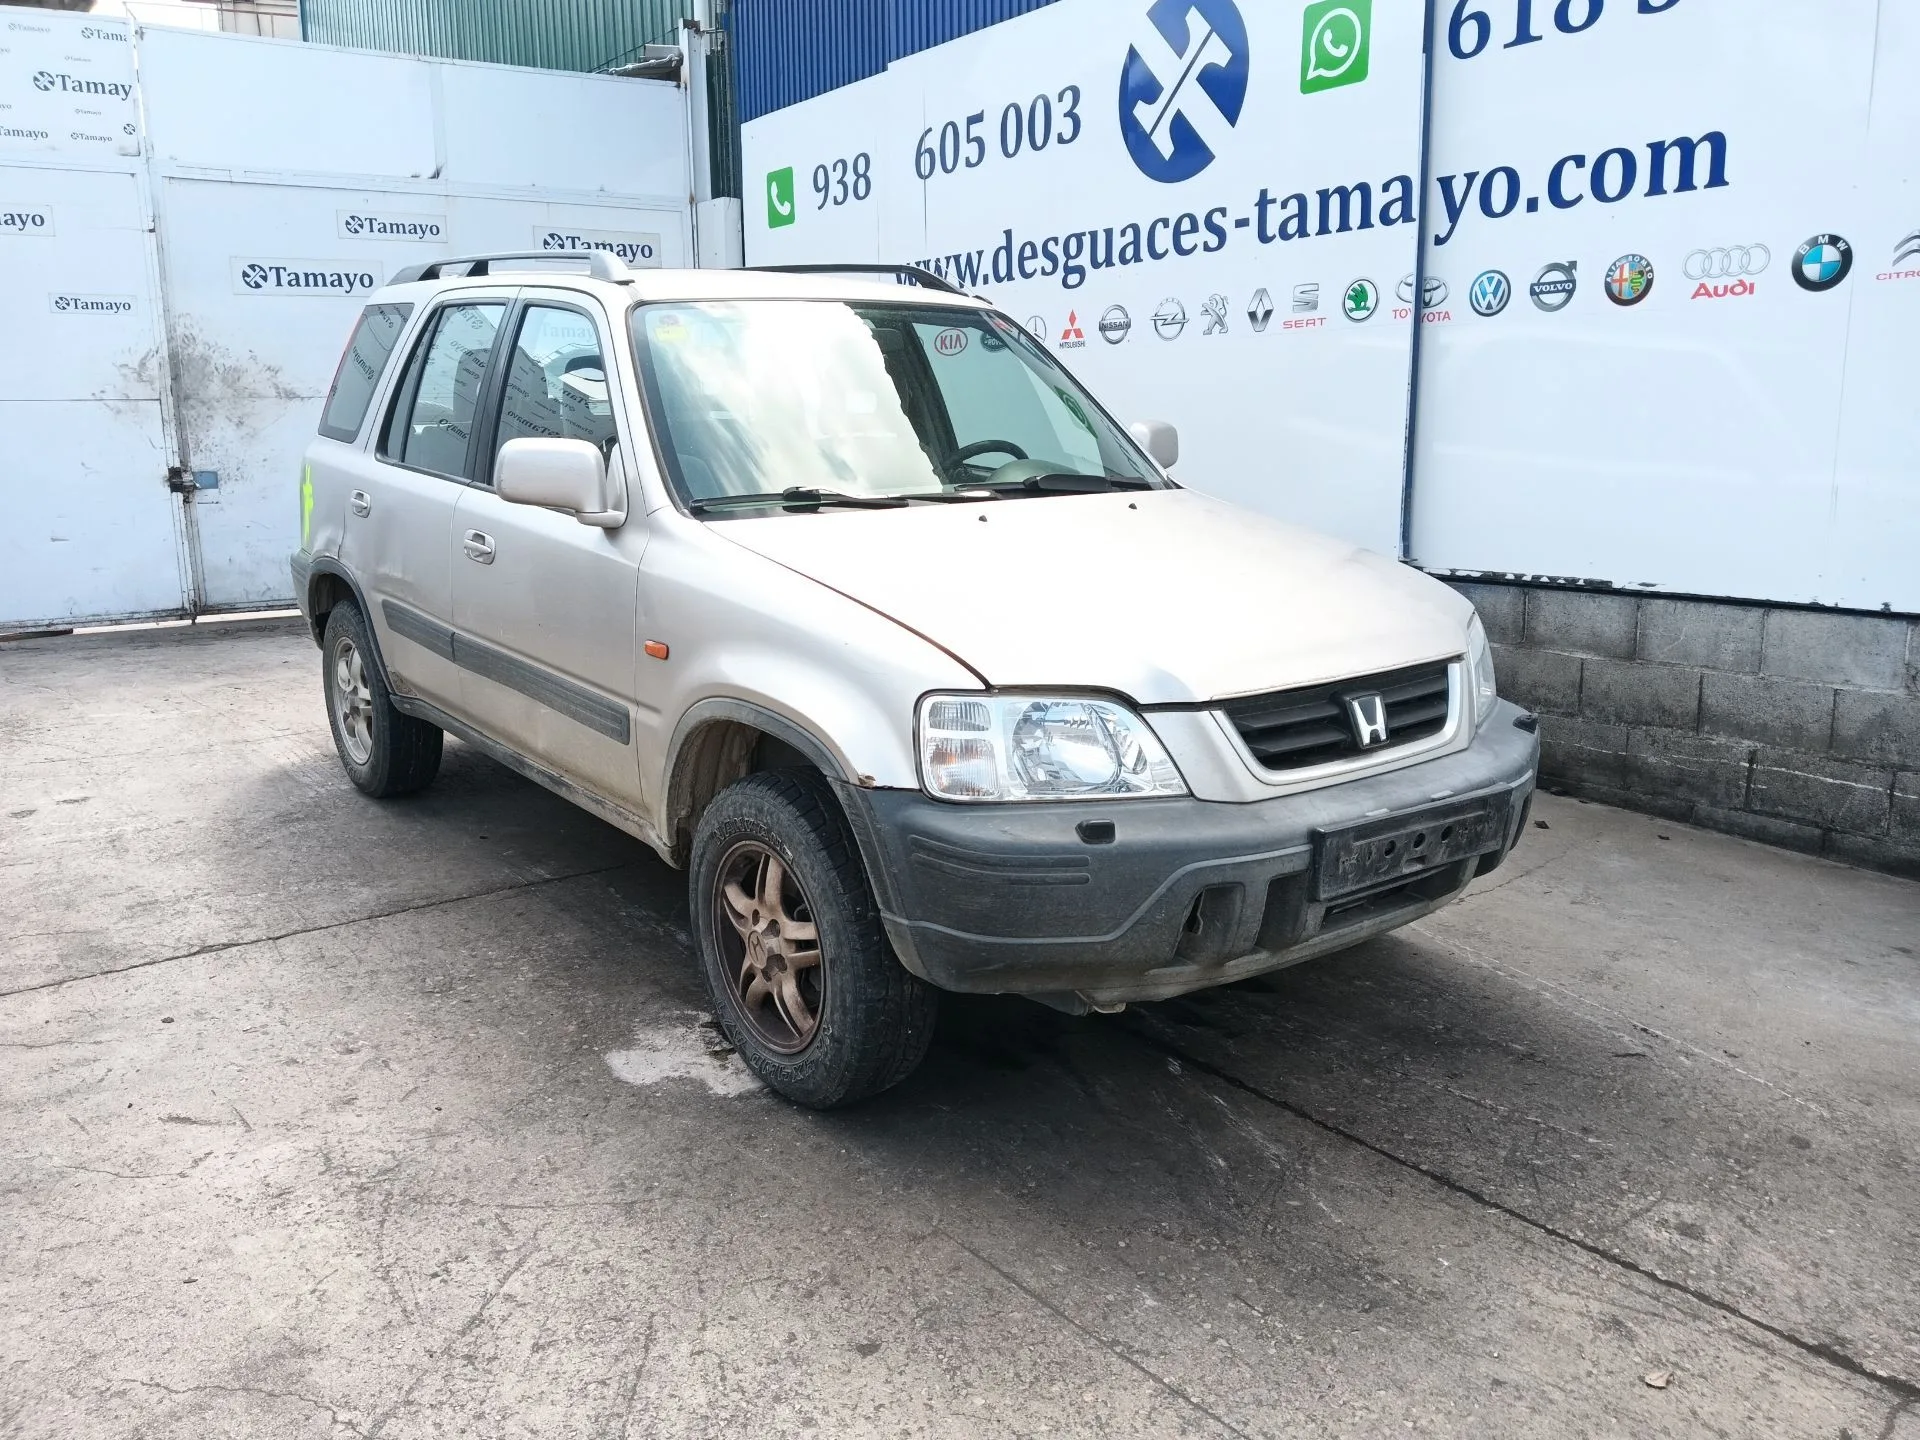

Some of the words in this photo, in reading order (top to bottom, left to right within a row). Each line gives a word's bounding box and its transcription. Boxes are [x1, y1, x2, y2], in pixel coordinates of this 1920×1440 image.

[79, 133, 112, 143] Tamayo
[813, 152, 872, 210] 938
[915, 109, 986, 180] 605
[999, 85, 1082, 159] 003
[0, 213, 45, 231] ayo
[364, 217, 440, 240] Tamayo
[269, 266, 374, 294] Tamayo
[1533, 282, 1573, 294] VOLVO
[1690, 279, 1756, 300] Audi
[70, 298, 132, 314] Tamayo
[1101, 320, 1129, 329] NISSAN
[1283, 317, 1327, 330] SEAT
[940, 334, 962, 350] KIA
